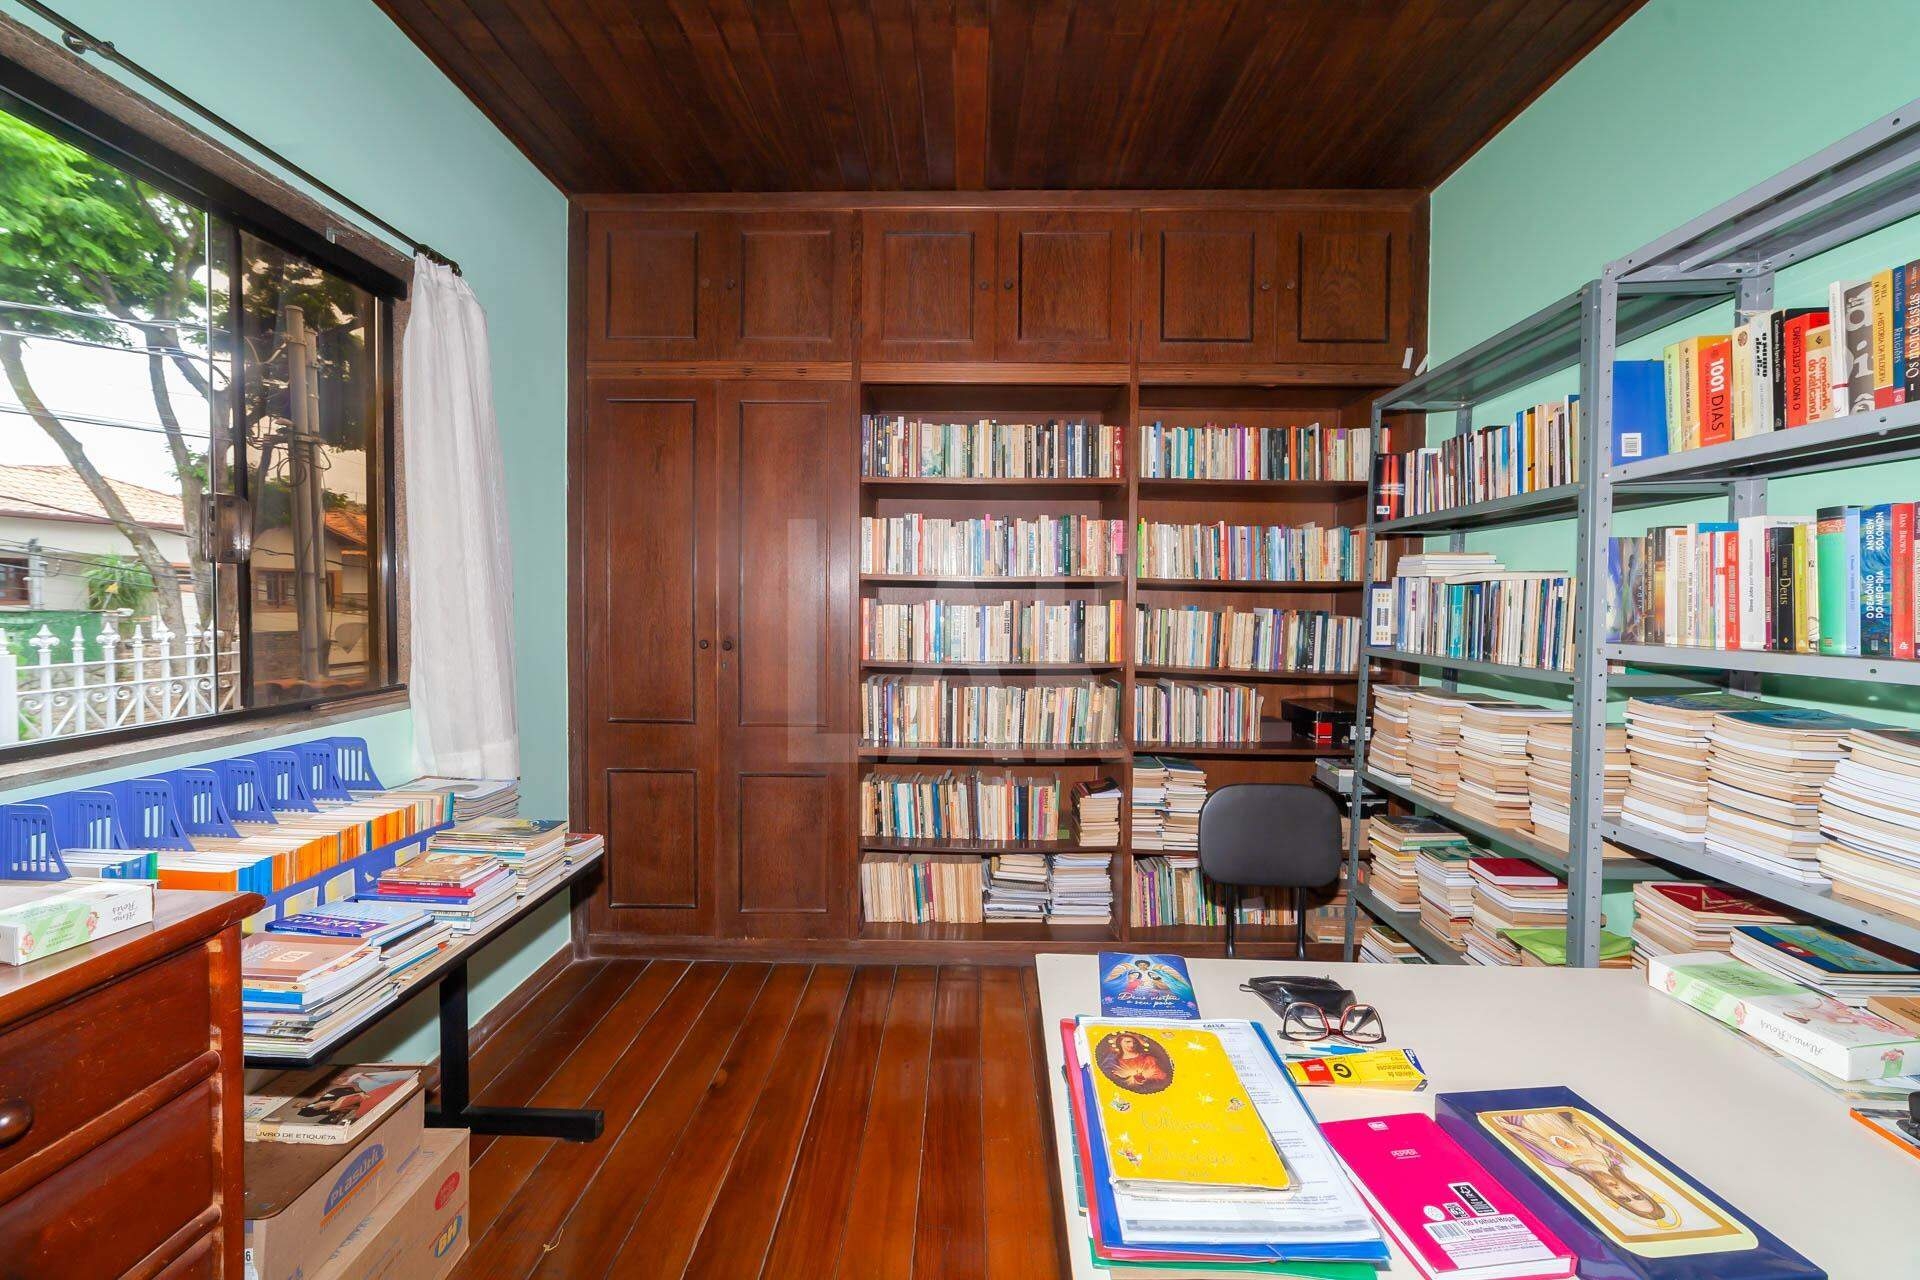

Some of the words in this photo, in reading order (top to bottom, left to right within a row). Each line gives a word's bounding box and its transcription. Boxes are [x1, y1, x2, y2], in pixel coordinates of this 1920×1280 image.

[1791, 326, 1802, 374] CATECISMO
[1708, 357, 1725, 393] 1001
[1809, 359, 1819, 372] do
[1905, 354, 1919, 379] Os
[1792, 375, 1801, 400] NOVO
[1808, 372, 1820, 414] vaticano
[1710, 394, 1725, 432] DIAS
[1793, 403, 1801, 411] O
[1875, 511, 1884, 551] SOLOMON
[1899, 513, 1907, 528] DAN
[1866, 518, 1874, 551] ANDREW
[1899, 530, 1907, 554] BROWN
[1865, 574, 1874, 612] DEMÔNIO
[1875, 570, 1884, 606] MEIO-DIA
[1875, 606, 1884, 619] DO
[1117, 992, 1147, 1001] Deus
[1333, 1063, 1353, 1079] G
